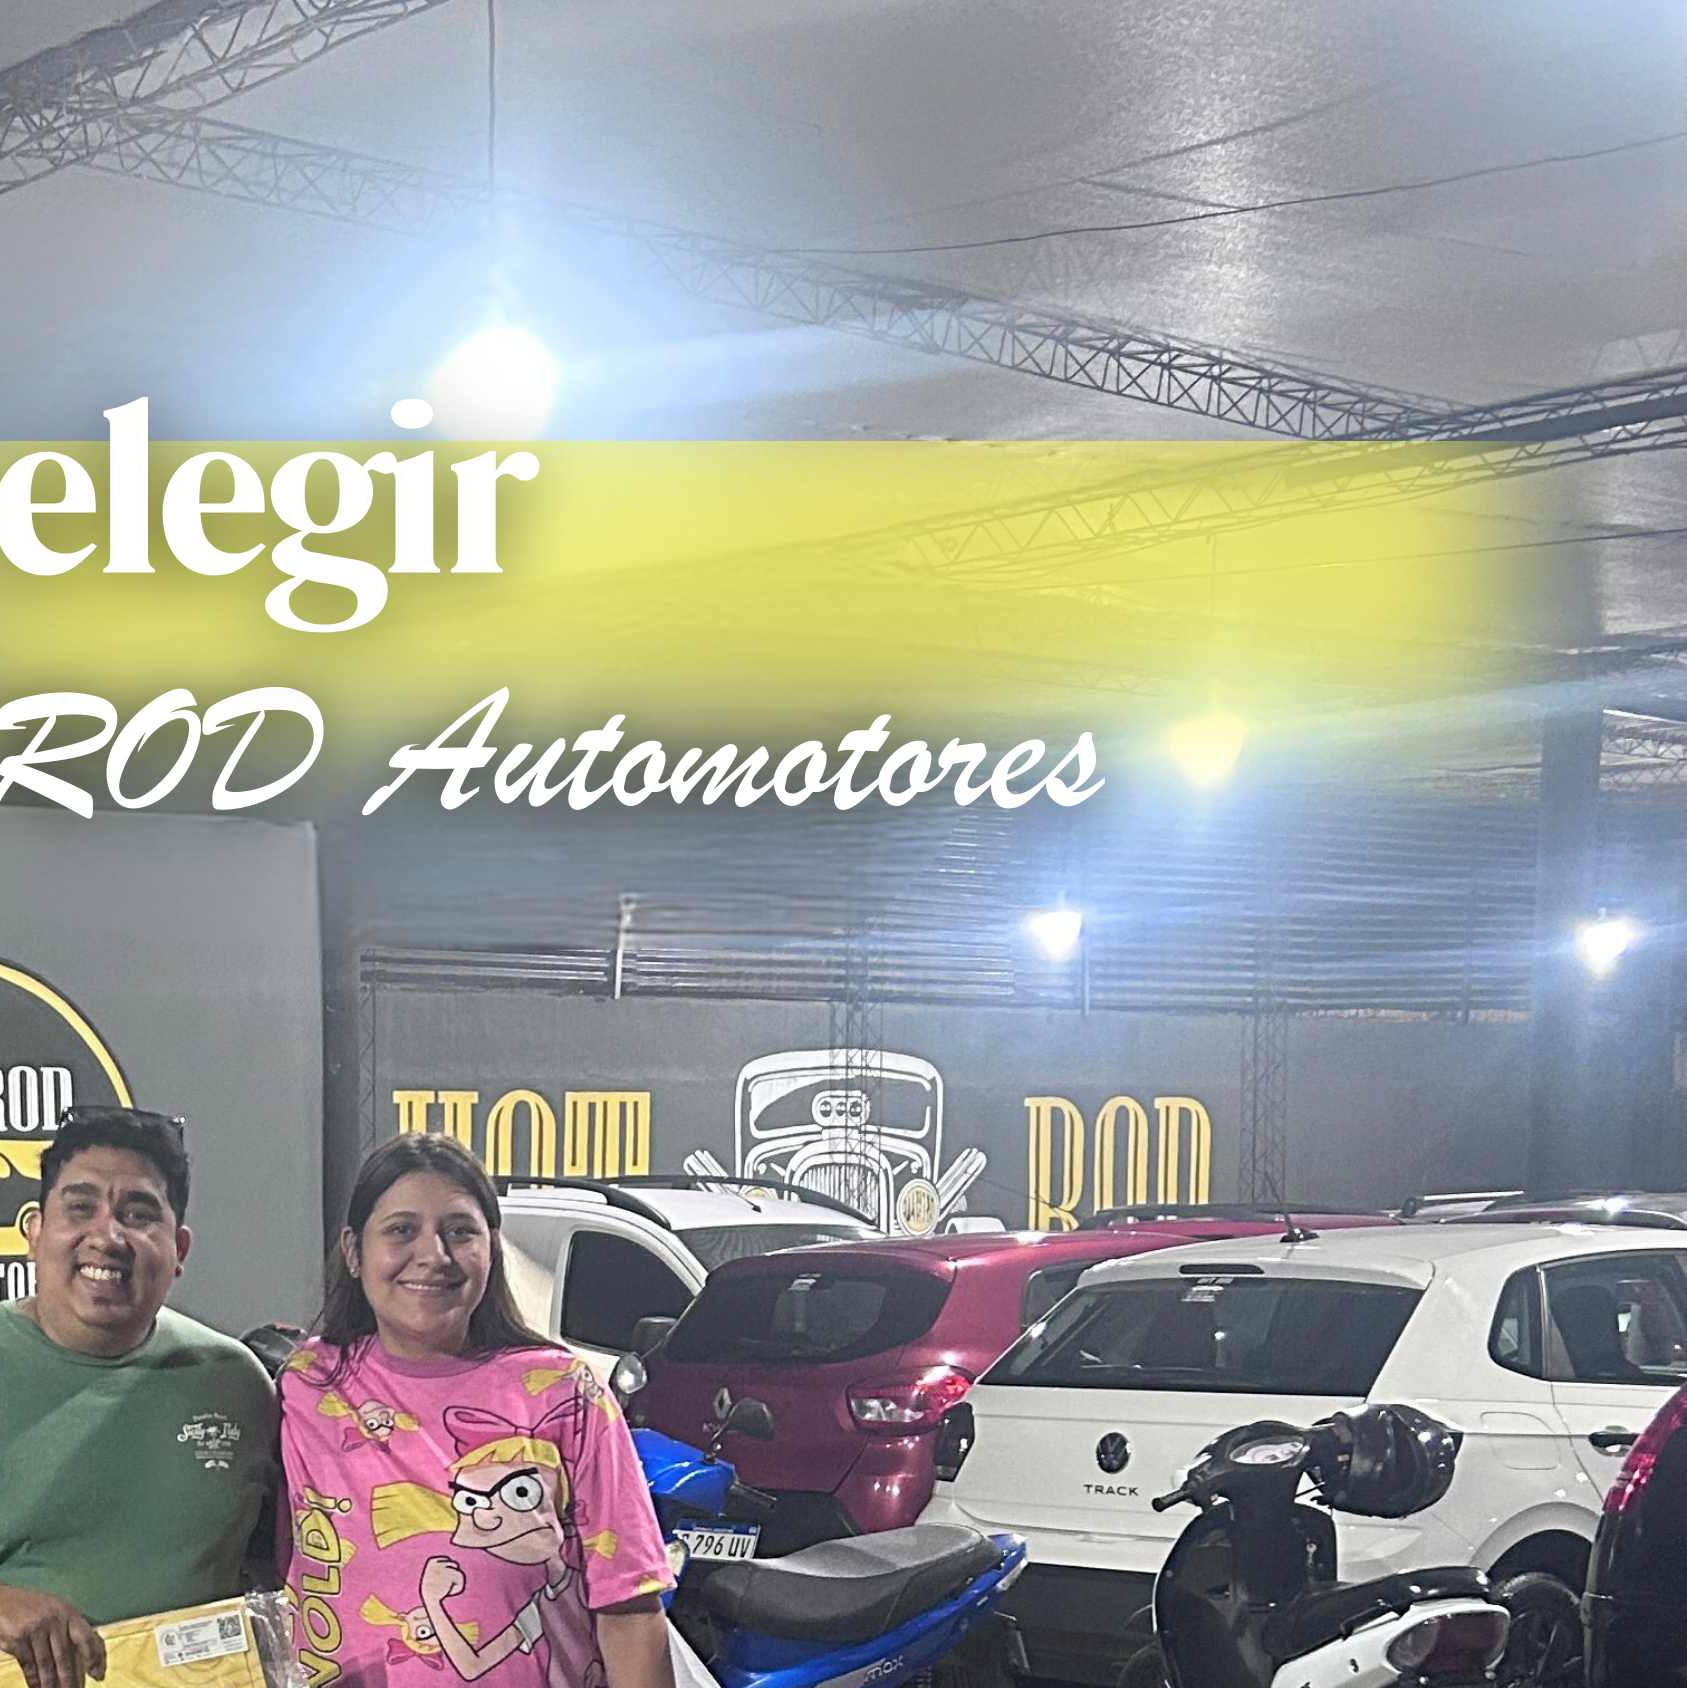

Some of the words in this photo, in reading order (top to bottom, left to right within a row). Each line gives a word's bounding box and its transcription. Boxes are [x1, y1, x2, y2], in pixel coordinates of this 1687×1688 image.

[1024, 1096, 1212, 1232] ROD
[1083, 1483, 1140, 1497] TRACK
[692, 1533, 725, 1556] 796
[728, 1536, 752, 1558] UV
